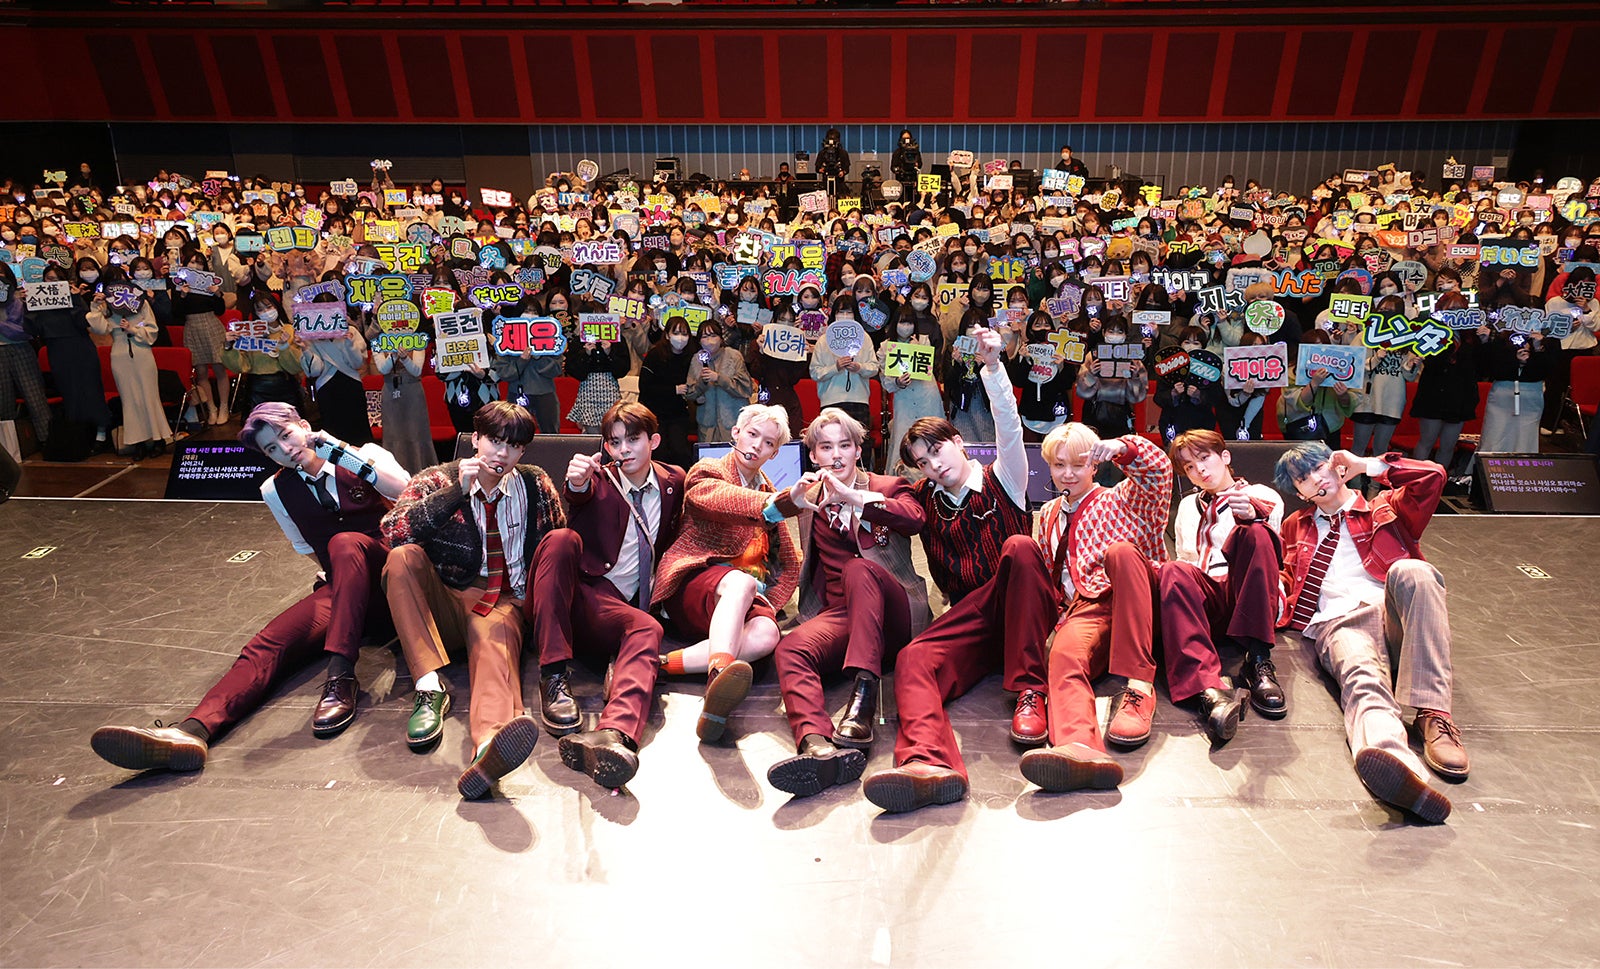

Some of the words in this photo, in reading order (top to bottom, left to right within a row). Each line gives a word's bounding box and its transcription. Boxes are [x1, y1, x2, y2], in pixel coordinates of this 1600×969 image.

[919, 176, 940, 190] 동건
[839, 199, 859, 207] J.YOU
[1255, 214, 1287, 224] J.YOU
[269, 228, 315, 248] 렌타
[376, 245, 421, 270] 동건
[575, 243, 620, 262] れんた
[734, 233, 762, 264] 찬
[771, 246, 825, 269] 재윤
[1482, 247, 1539, 266] だいご
[990, 260, 1023, 280] 지수
[1315, 262, 1341, 272] TO1
[574, 272, 611, 300] 大悟
[883, 270, 907, 286] 大悟
[1153, 272, 1208, 291] 다이고
[36, 284, 59, 296] 大悟
[350, 278, 407, 303] 재윤
[474, 286, 520, 304] だいご
[1562, 282, 1597, 299] 大悟
[28, 296, 71, 307] 会いたかった!
[608, 298, 646, 320] 렌타
[1048, 298, 1077, 317] 렌타
[1333, 299, 1369, 319] 렌타
[293, 315, 349, 331] れんた
[440, 315, 479, 336] 동건
[1504, 307, 1571, 336] れんた
[500, 321, 558, 351] 제유
[583, 324, 617, 340] 렌타
[832, 326, 857, 339] TO1
[1368, 317, 1446, 351] レンタ
[380, 335, 427, 351] J.YOU
[445, 339, 479, 354] 티오원
[763, 329, 806, 357] 사랑해
[1098, 344, 1145, 360] 다이고
[442, 353, 475, 367] 사랑해
[888, 349, 931, 374] 大悟
[1230, 358, 1283, 380] 제이유
[1311, 353, 1348, 369] DAIGO
